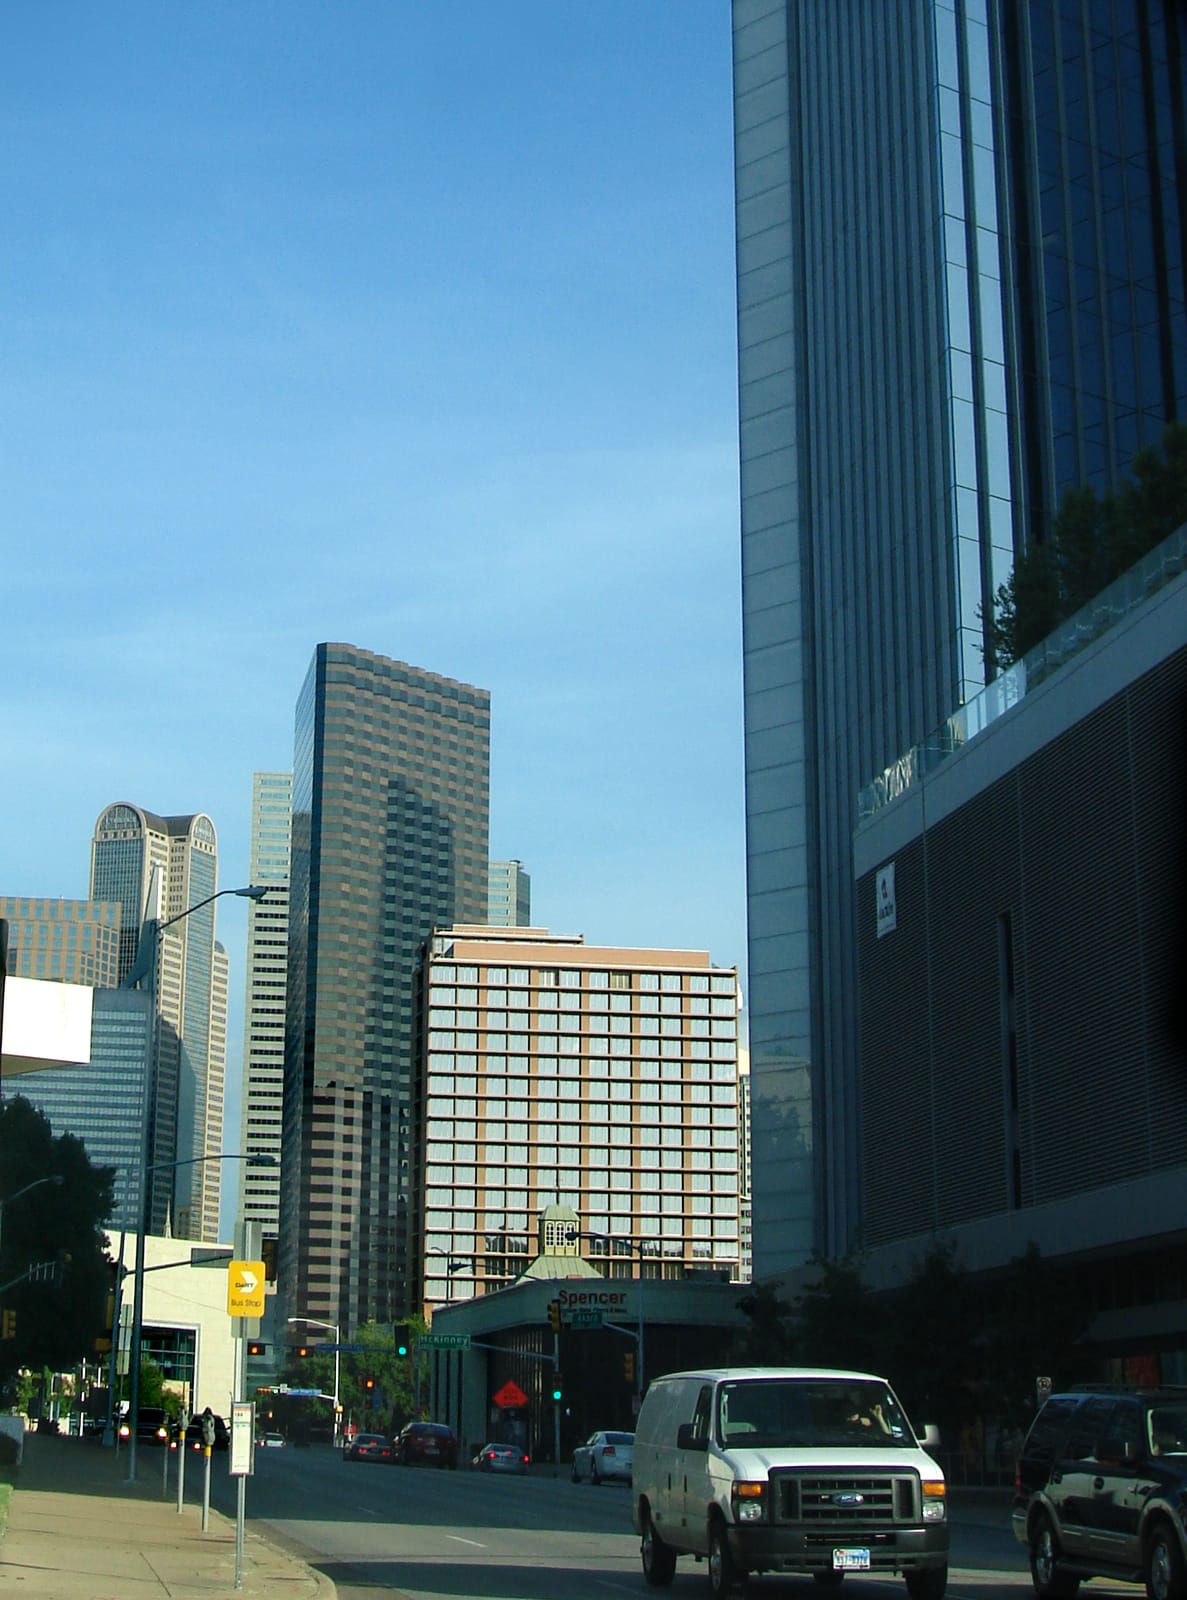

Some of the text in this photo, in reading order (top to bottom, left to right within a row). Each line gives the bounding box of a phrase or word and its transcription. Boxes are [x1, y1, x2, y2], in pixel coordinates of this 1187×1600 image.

[245, 1299, 262, 1308] Stop
[558, 1289, 627, 1307] Spencer
[420, 1335, 468, 1346] McKinney
